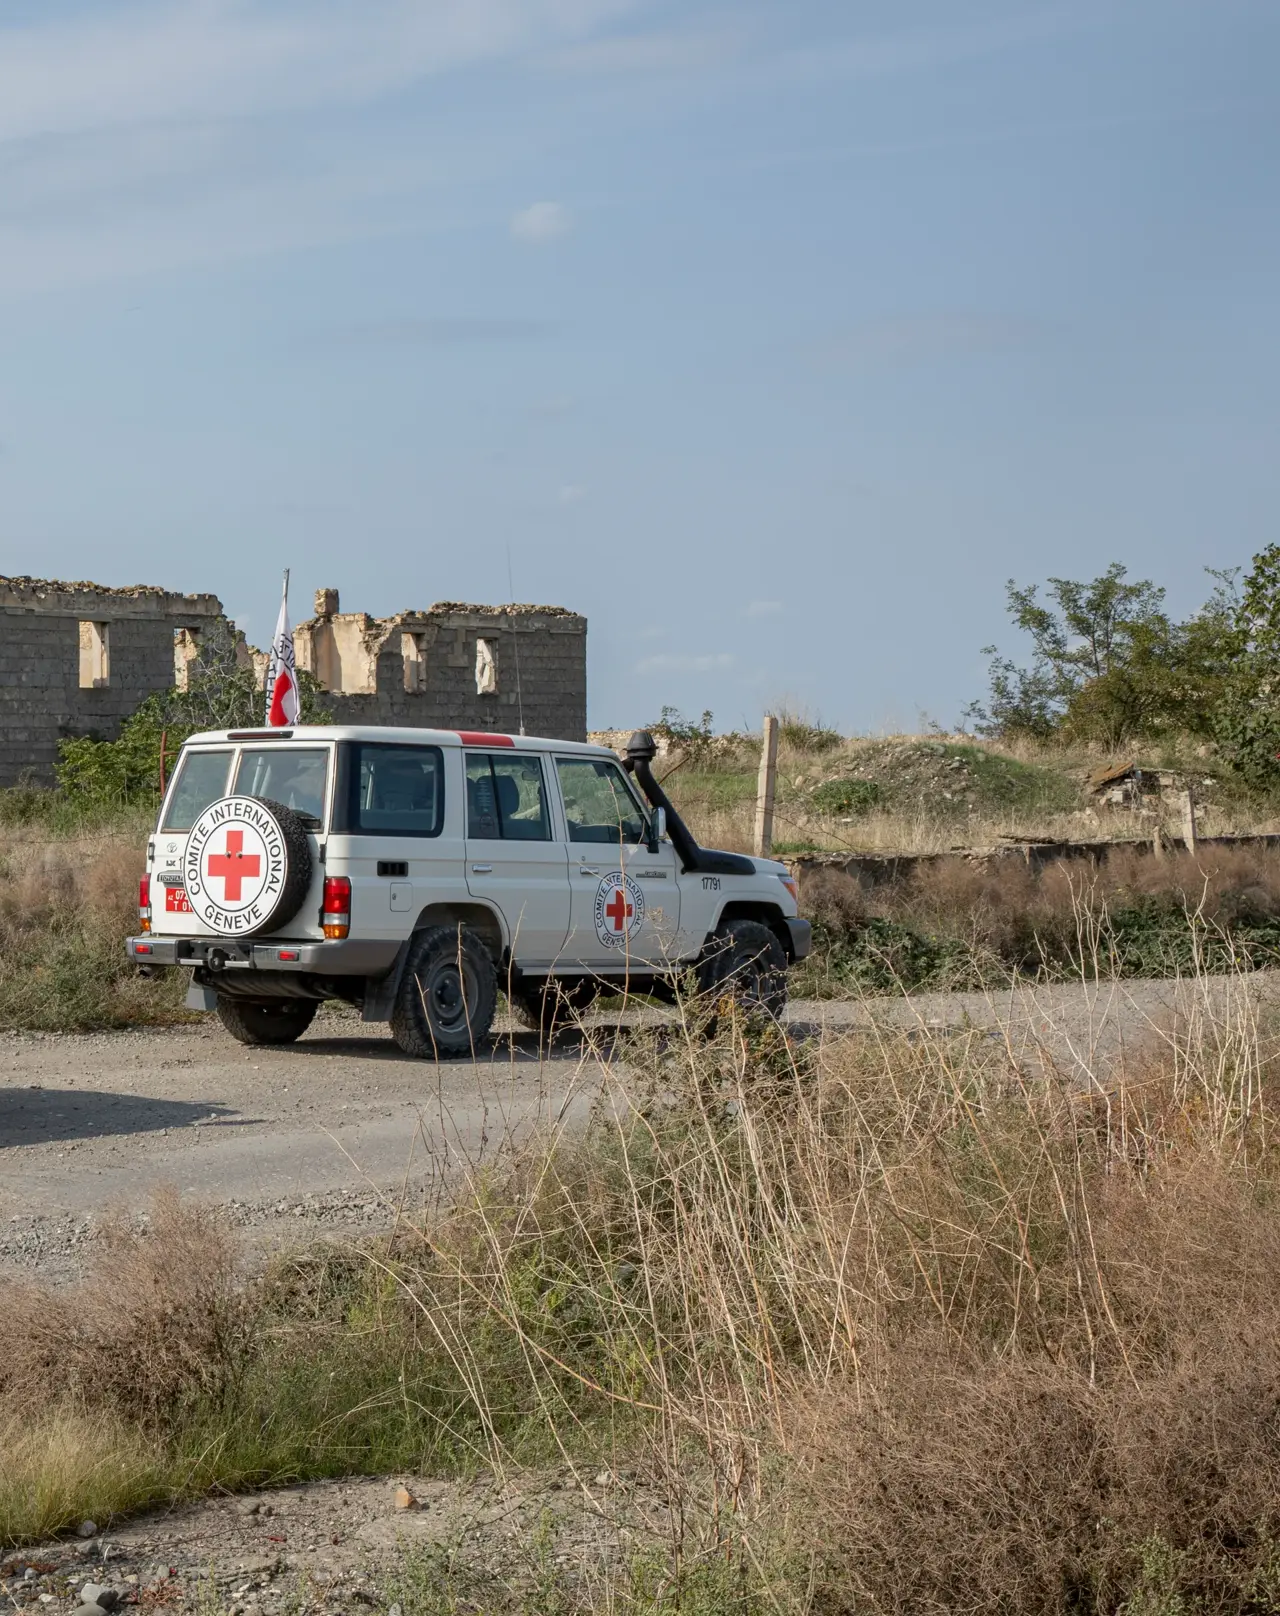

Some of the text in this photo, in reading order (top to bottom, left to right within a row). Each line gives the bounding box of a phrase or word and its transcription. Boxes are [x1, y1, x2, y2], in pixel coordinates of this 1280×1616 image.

[188, 803, 282, 895] COMITE INTERNATIONAL
[701, 877, 721, 890] 17791
[174, 901, 179, 911] T
[204, 904, 263, 929] GENEVE
